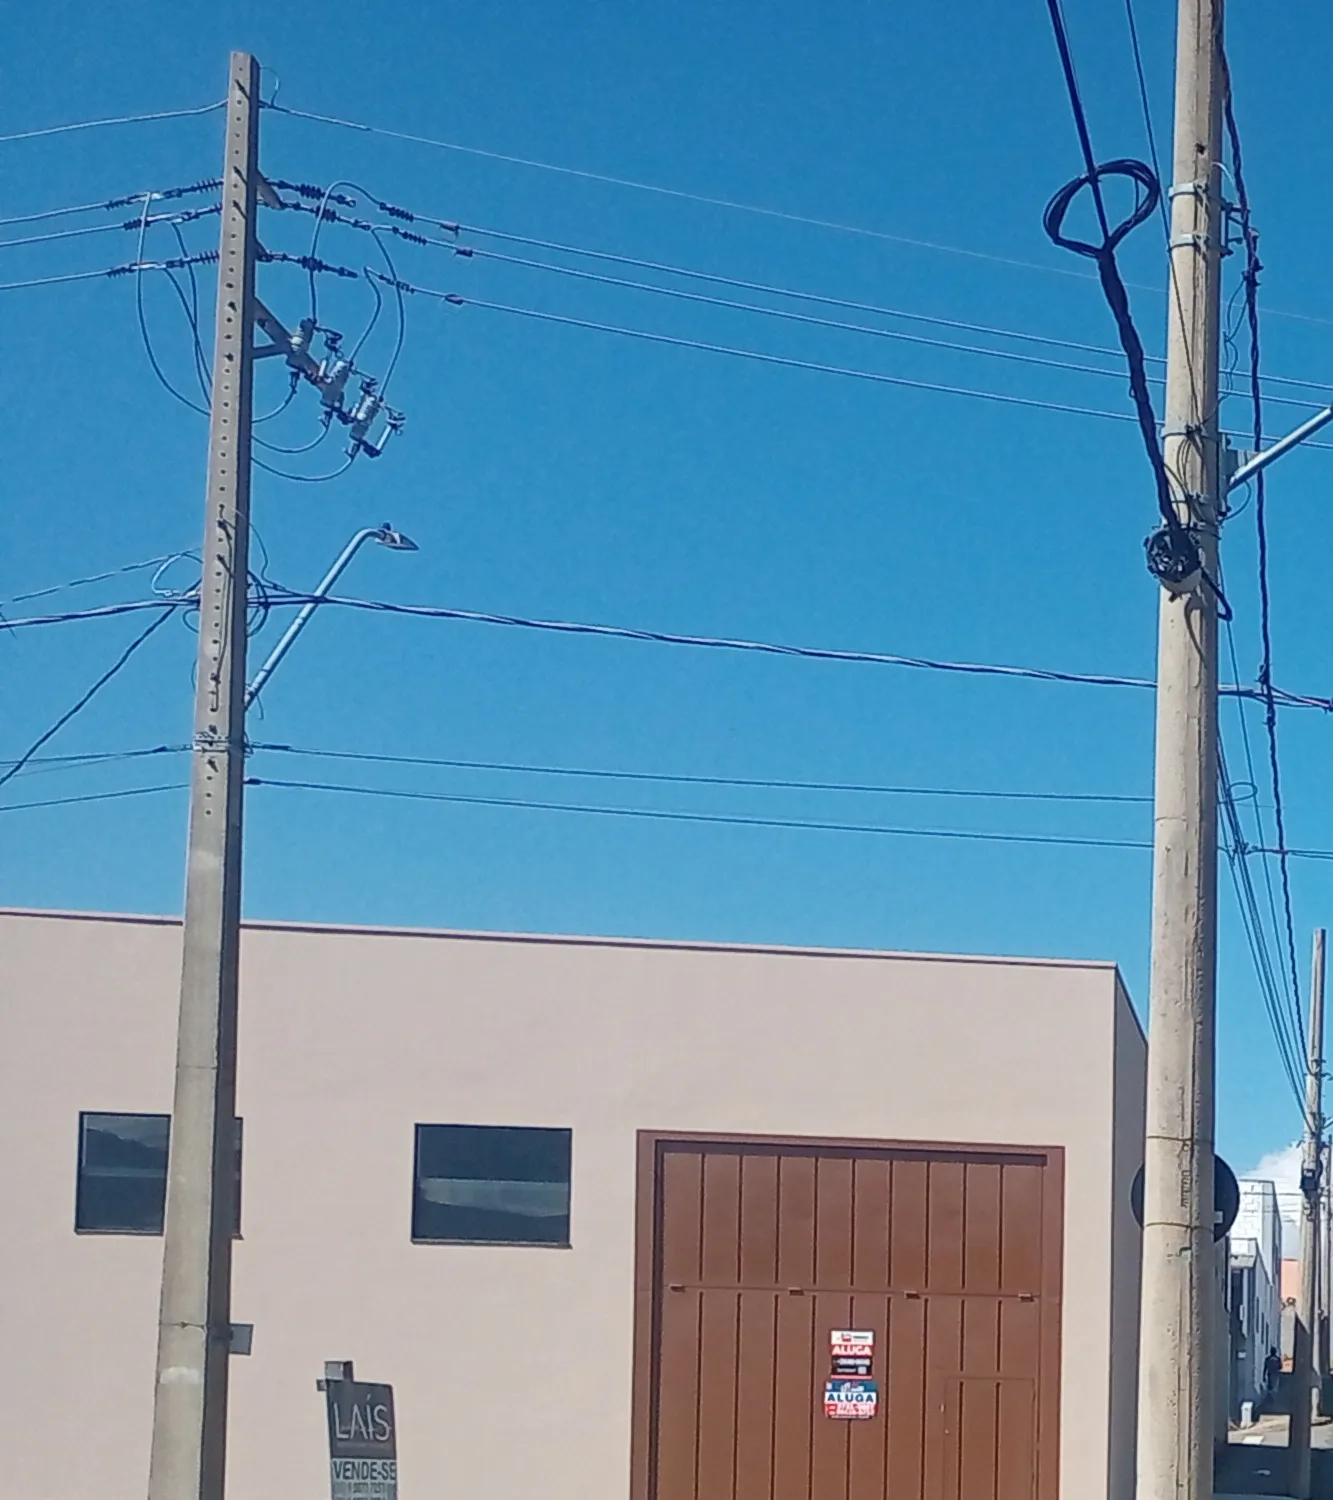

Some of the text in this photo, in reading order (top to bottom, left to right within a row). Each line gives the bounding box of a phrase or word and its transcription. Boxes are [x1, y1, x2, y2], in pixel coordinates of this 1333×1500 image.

[832, 1345, 872, 1356] ALUGA
[827, 1393, 874, 1403] ALUGA
[333, 1460, 397, 1481] VENDE-SE
